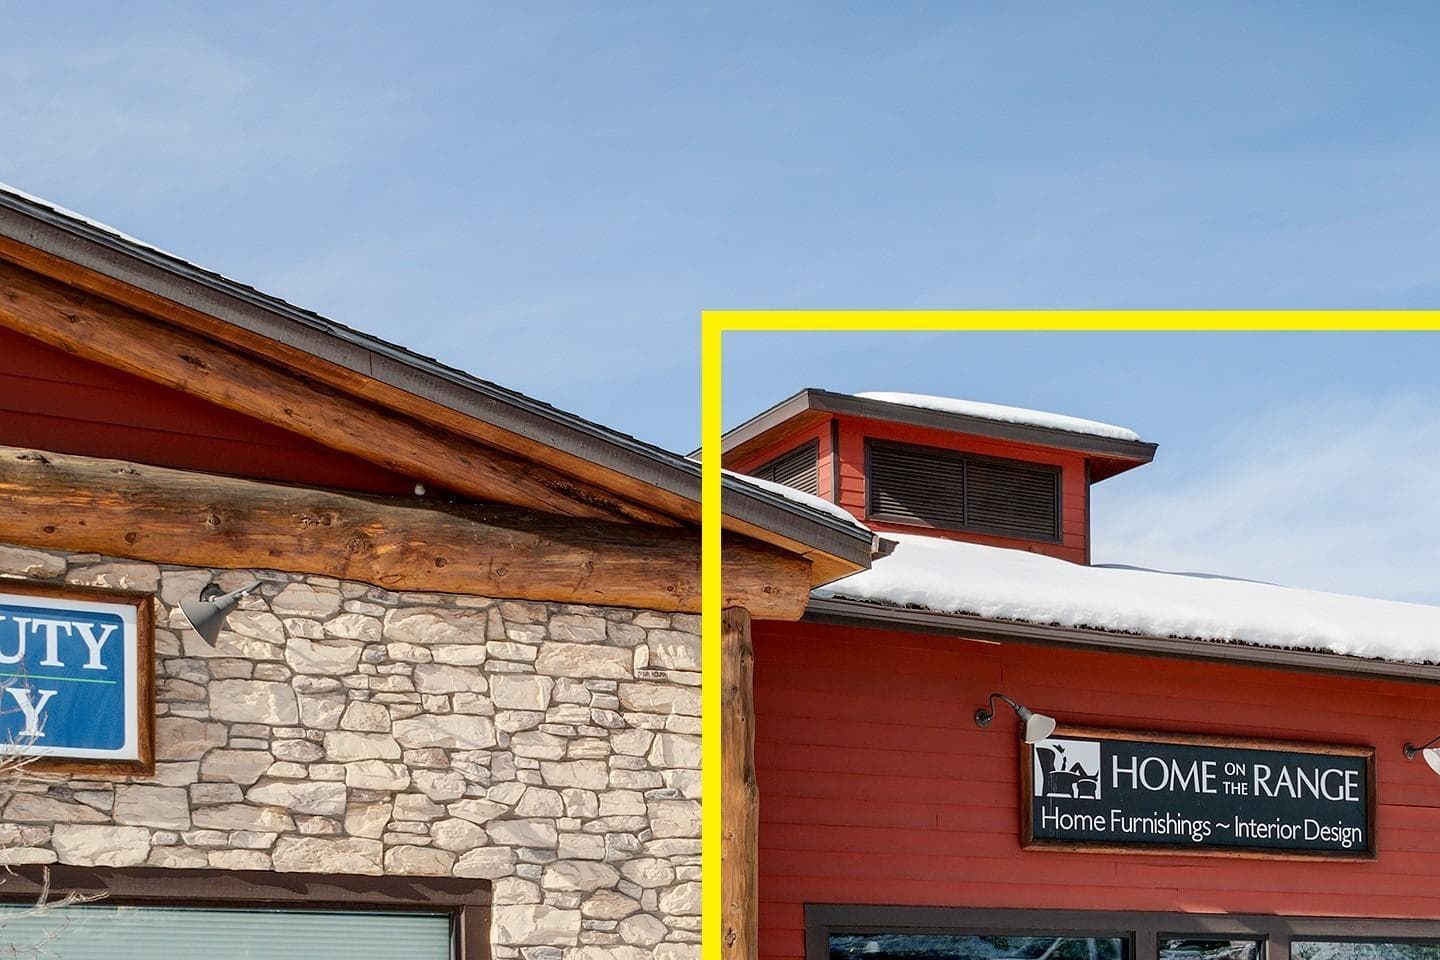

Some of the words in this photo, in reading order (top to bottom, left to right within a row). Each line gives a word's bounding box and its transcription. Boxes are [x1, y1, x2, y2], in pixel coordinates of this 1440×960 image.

[0, 616, 118, 670] UTY
[1112, 755, 1217, 794] HOME
[1224, 762, 1246, 776] ON
[1254, 764, 1359, 801] RANGE
[1223, 781, 1248, 796] THE
[1041, 806, 1105, 832] Home
[1111, 810, 1211, 842] Furnishings
[1234, 816, 1302, 840] Interior
[1304, 819, 1362, 848] Design
